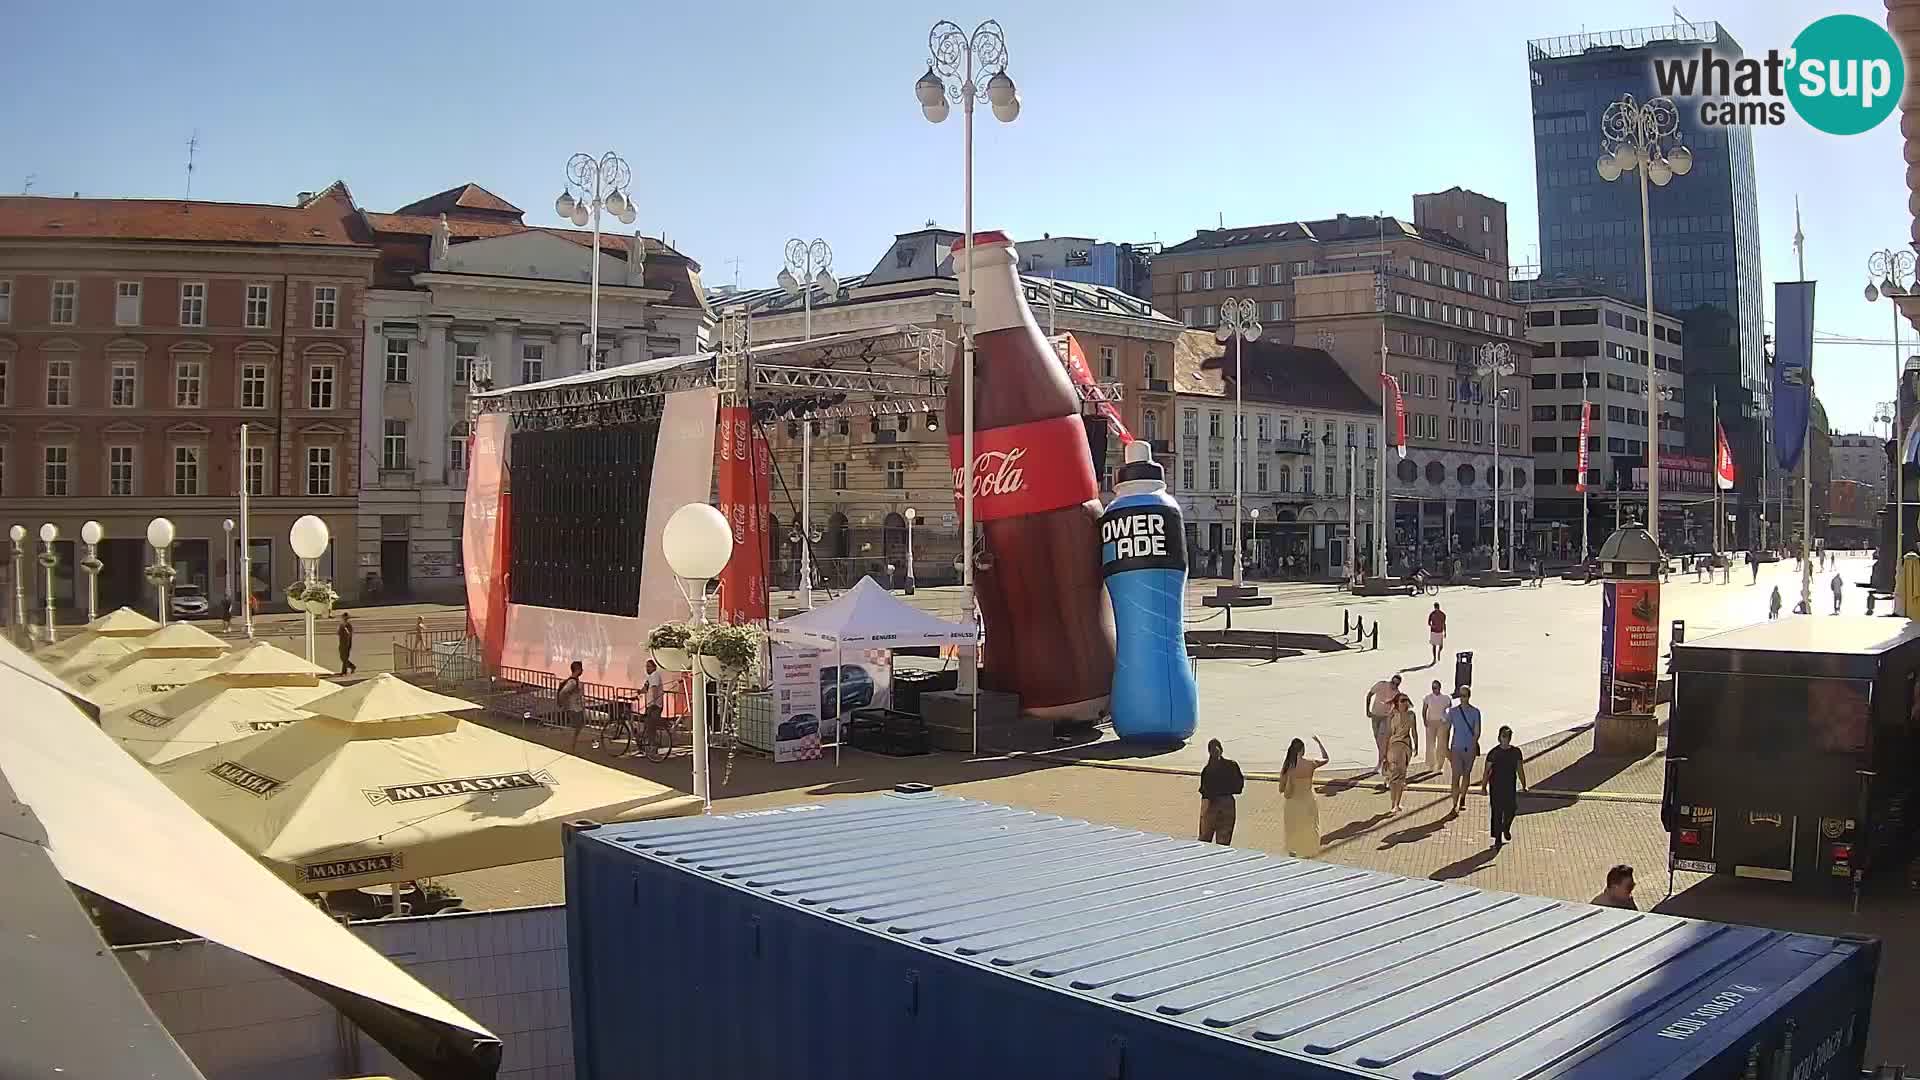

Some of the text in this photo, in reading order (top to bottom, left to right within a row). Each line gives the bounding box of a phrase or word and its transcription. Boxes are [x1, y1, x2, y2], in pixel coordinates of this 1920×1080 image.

[1103, 514, 1165, 543] OWER
[1117, 535, 1167, 560] ADE
[394, 775, 532, 801] MARASKA
[311, 857, 389, 878] MARASKA
[1689, 991, 1745, 1020] 300629
